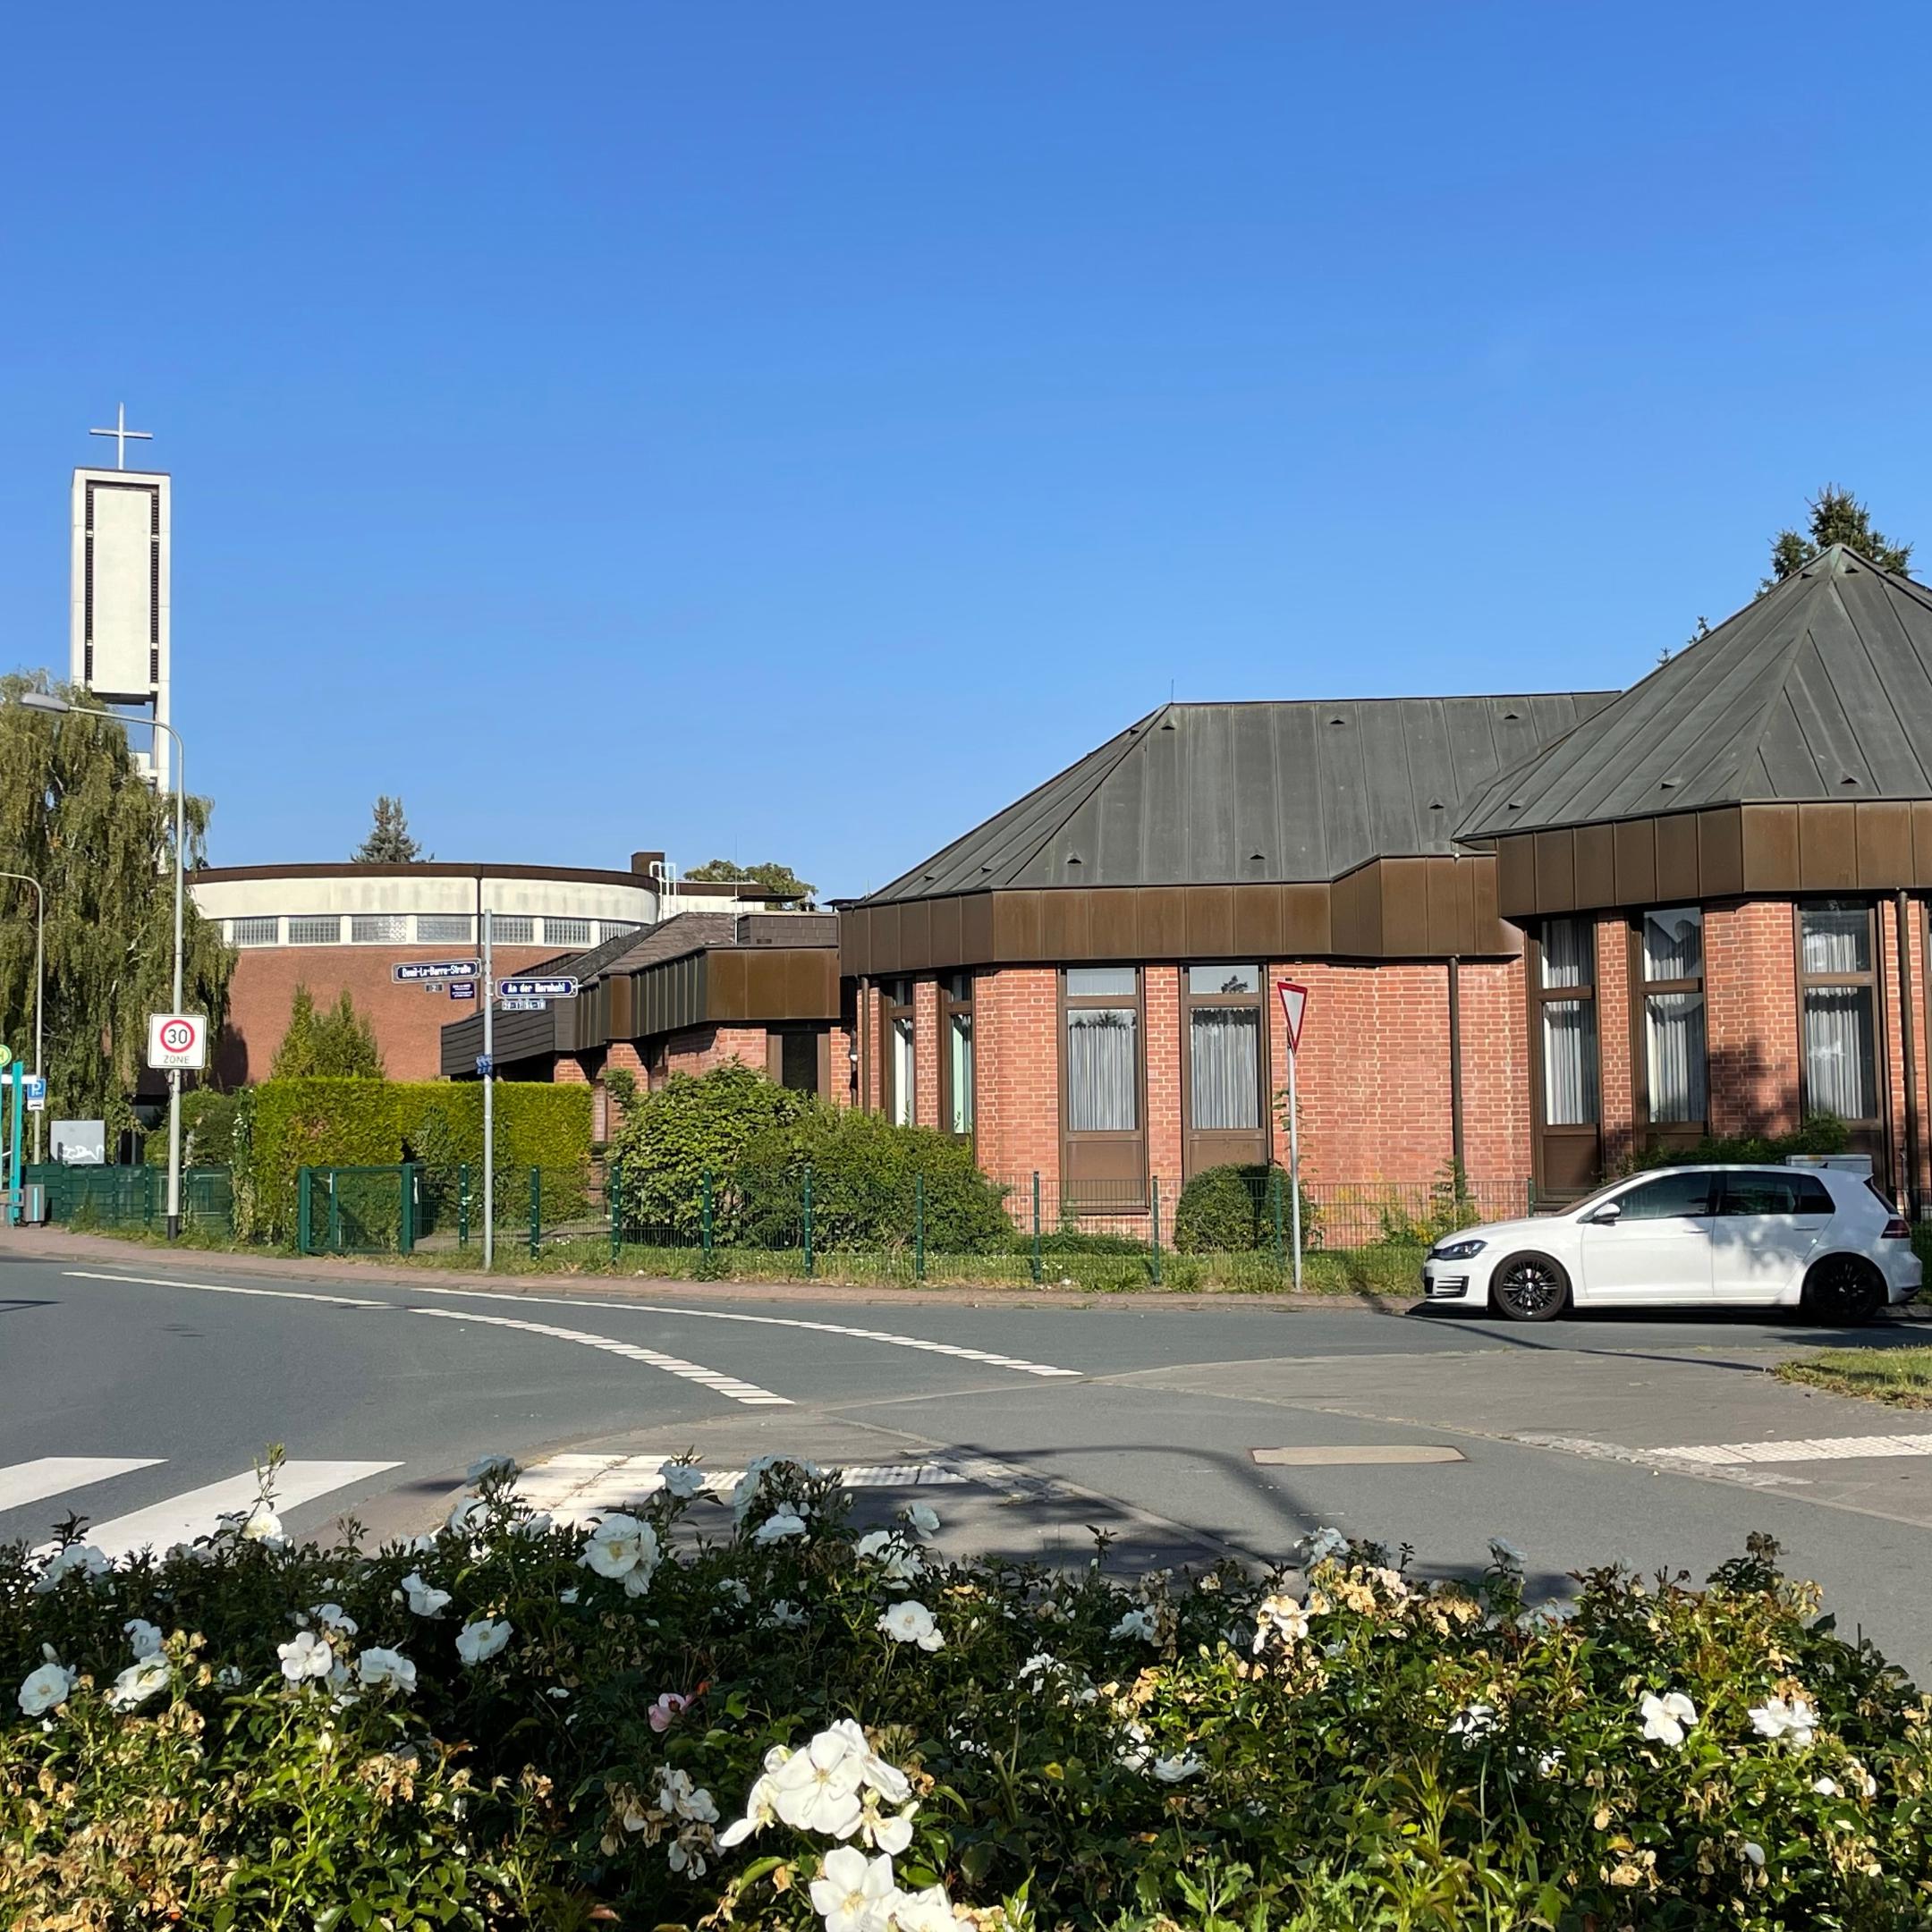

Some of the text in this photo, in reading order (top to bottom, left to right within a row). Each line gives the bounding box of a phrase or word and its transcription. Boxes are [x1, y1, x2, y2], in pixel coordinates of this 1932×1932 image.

[508, 983, 517, 993] An
[520, 983, 532, 993] der
[167, 1029, 188, 1044] 30
[163, 1055, 191, 1064] ZONE
